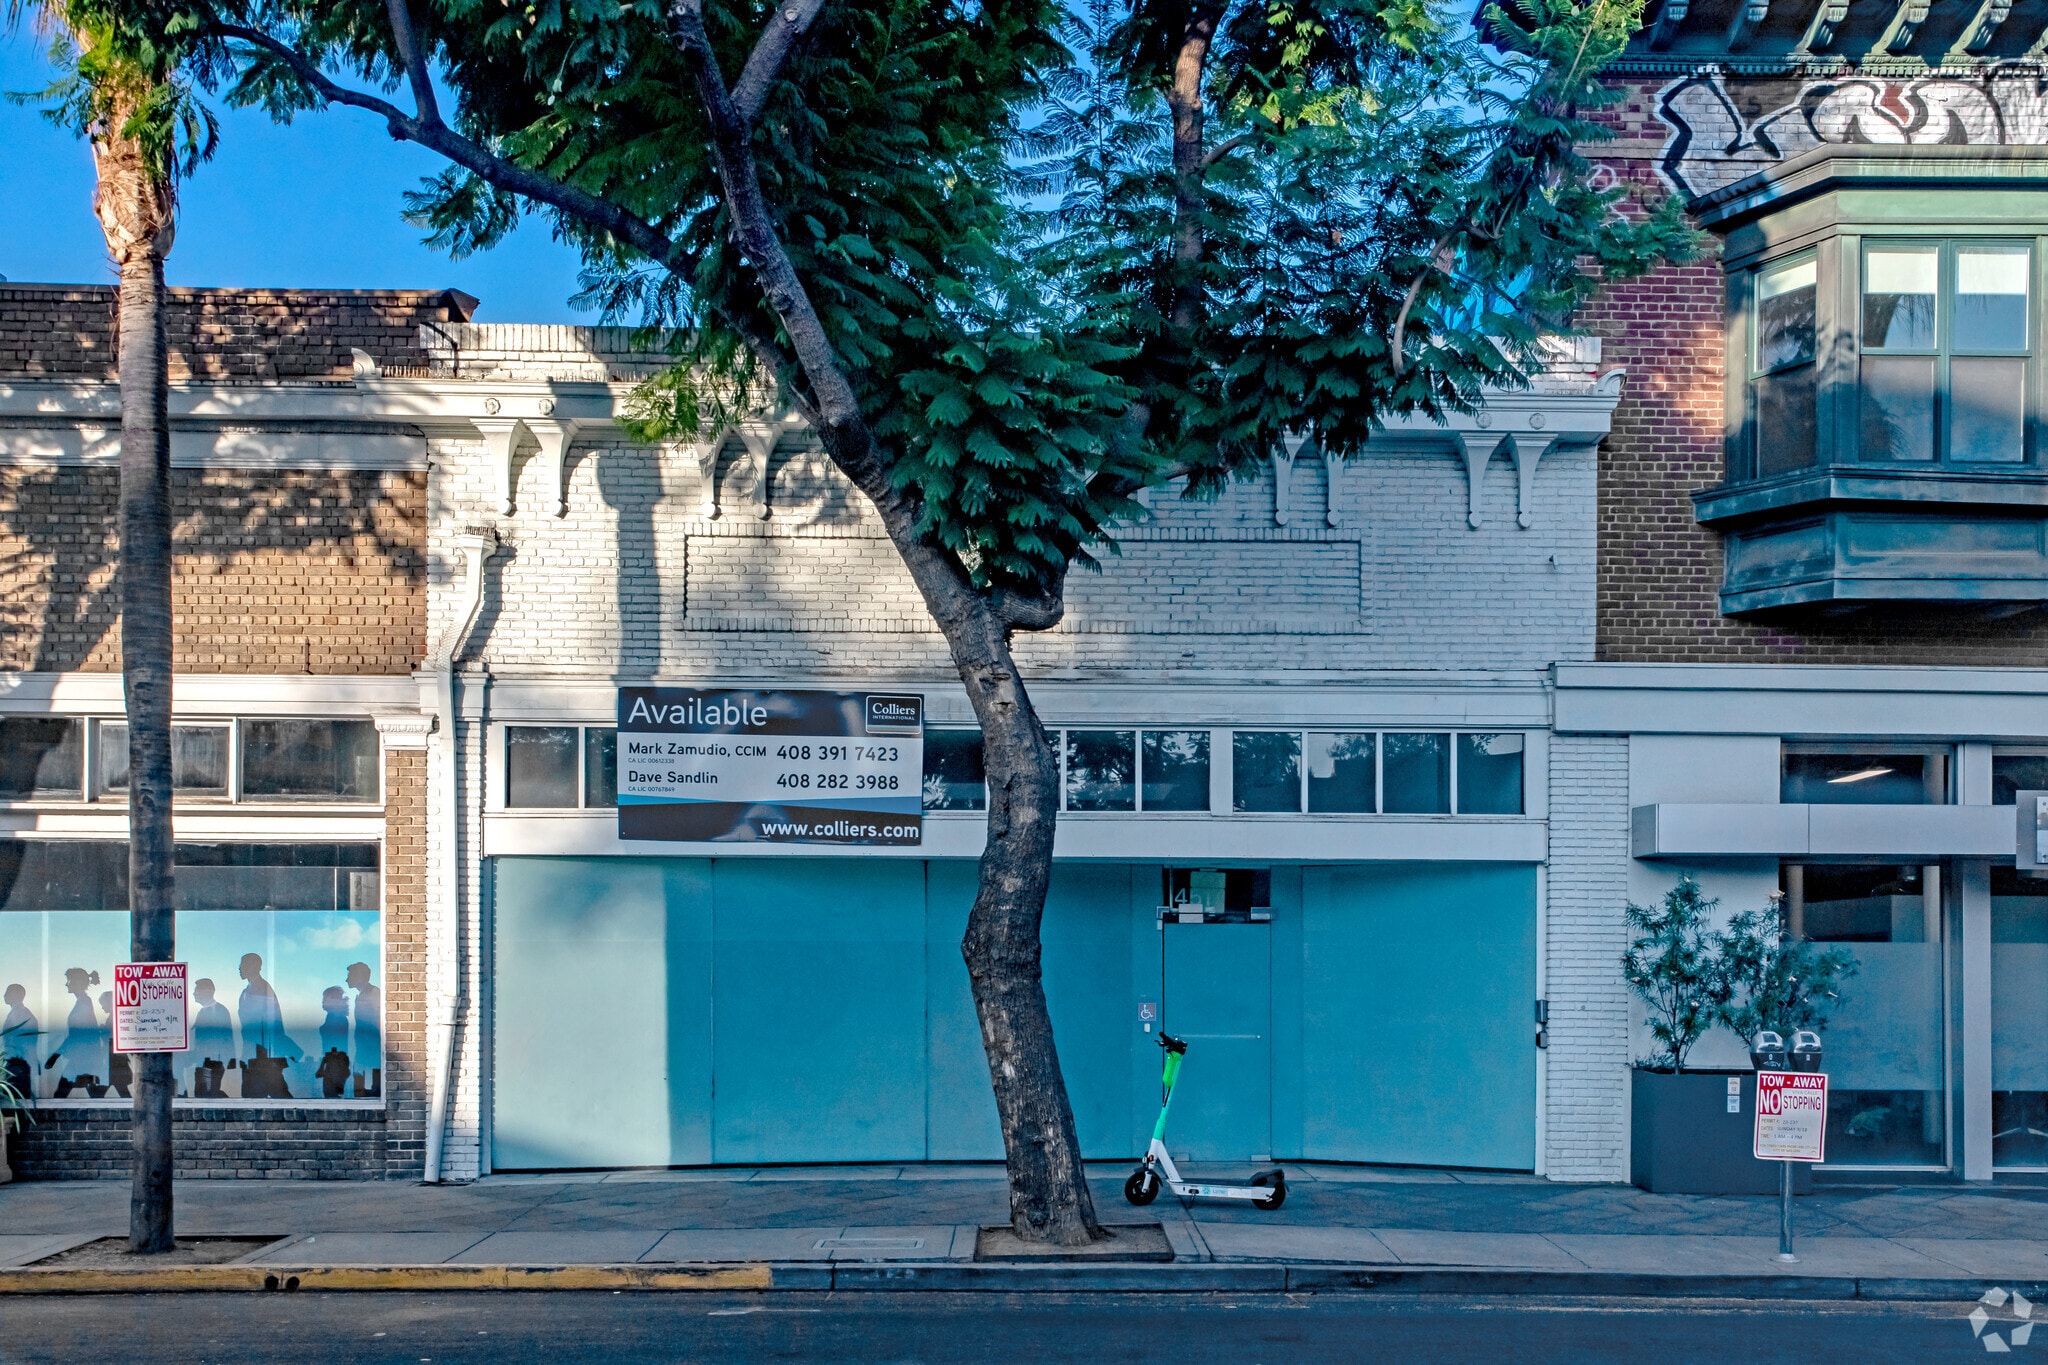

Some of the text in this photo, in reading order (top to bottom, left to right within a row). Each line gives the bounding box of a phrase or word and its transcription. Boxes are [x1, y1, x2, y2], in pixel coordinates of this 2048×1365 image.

[627, 696, 768, 727] Available
[872, 702, 916, 715] Colliers
[628, 742, 899, 761] Mark Zamudio, CCIM 408 391 7423
[628, 770, 899, 790] Dave Sandlin 408 282 3988
[761, 820, 919, 838] www.colliers.com
[116, 966, 144, 978] TOW
[152, 966, 185, 978] AWAY
[116, 980, 183, 1006] NO STOPPING
[1761, 1075, 1785, 1087] TOW
[1793, 1077, 1824, 1088] AWAY
[1760, 1089, 1781, 1114] NO
[1783, 1095, 1821, 1110] STOPPING
